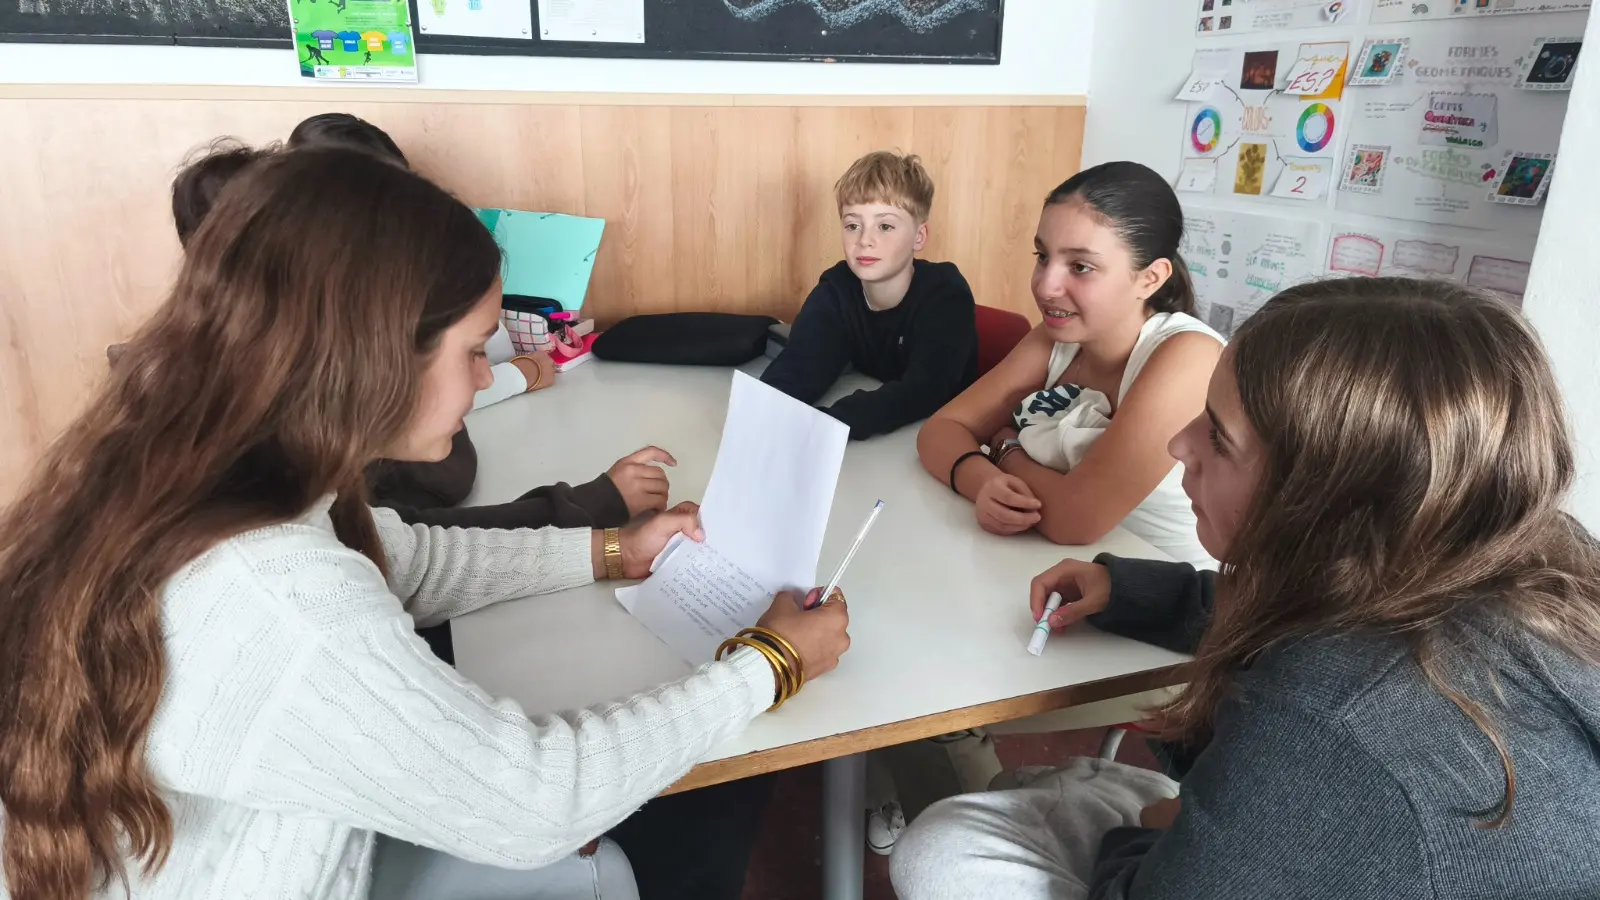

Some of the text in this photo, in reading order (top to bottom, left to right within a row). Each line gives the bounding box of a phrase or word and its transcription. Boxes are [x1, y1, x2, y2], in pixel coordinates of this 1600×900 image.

[1189, 80, 1211, 93] ES?
[1289, 68, 1335, 93] ES?
[1290, 175, 1307, 194] 2
